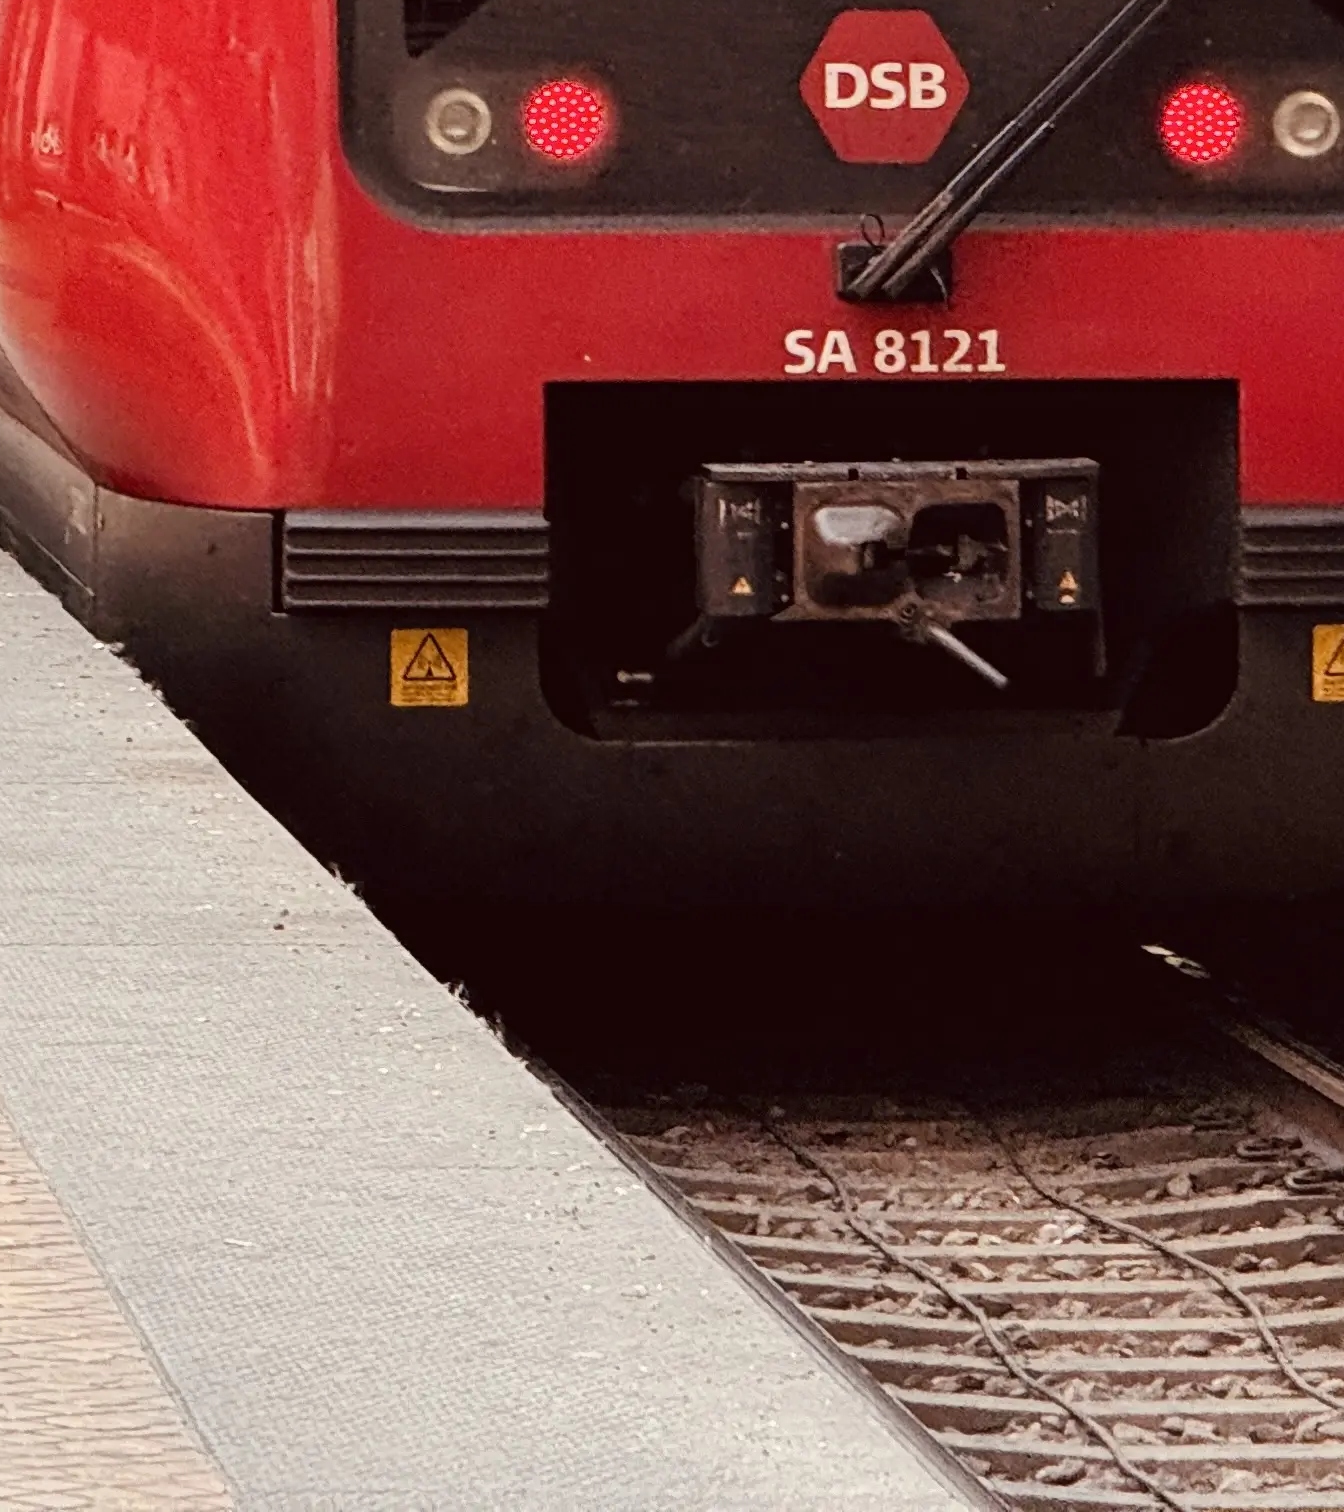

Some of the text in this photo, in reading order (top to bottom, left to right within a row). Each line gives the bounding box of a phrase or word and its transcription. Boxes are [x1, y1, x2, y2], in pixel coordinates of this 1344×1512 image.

[824, 62, 947, 110] DSB
[783, 329, 1006, 375] SA 8121
